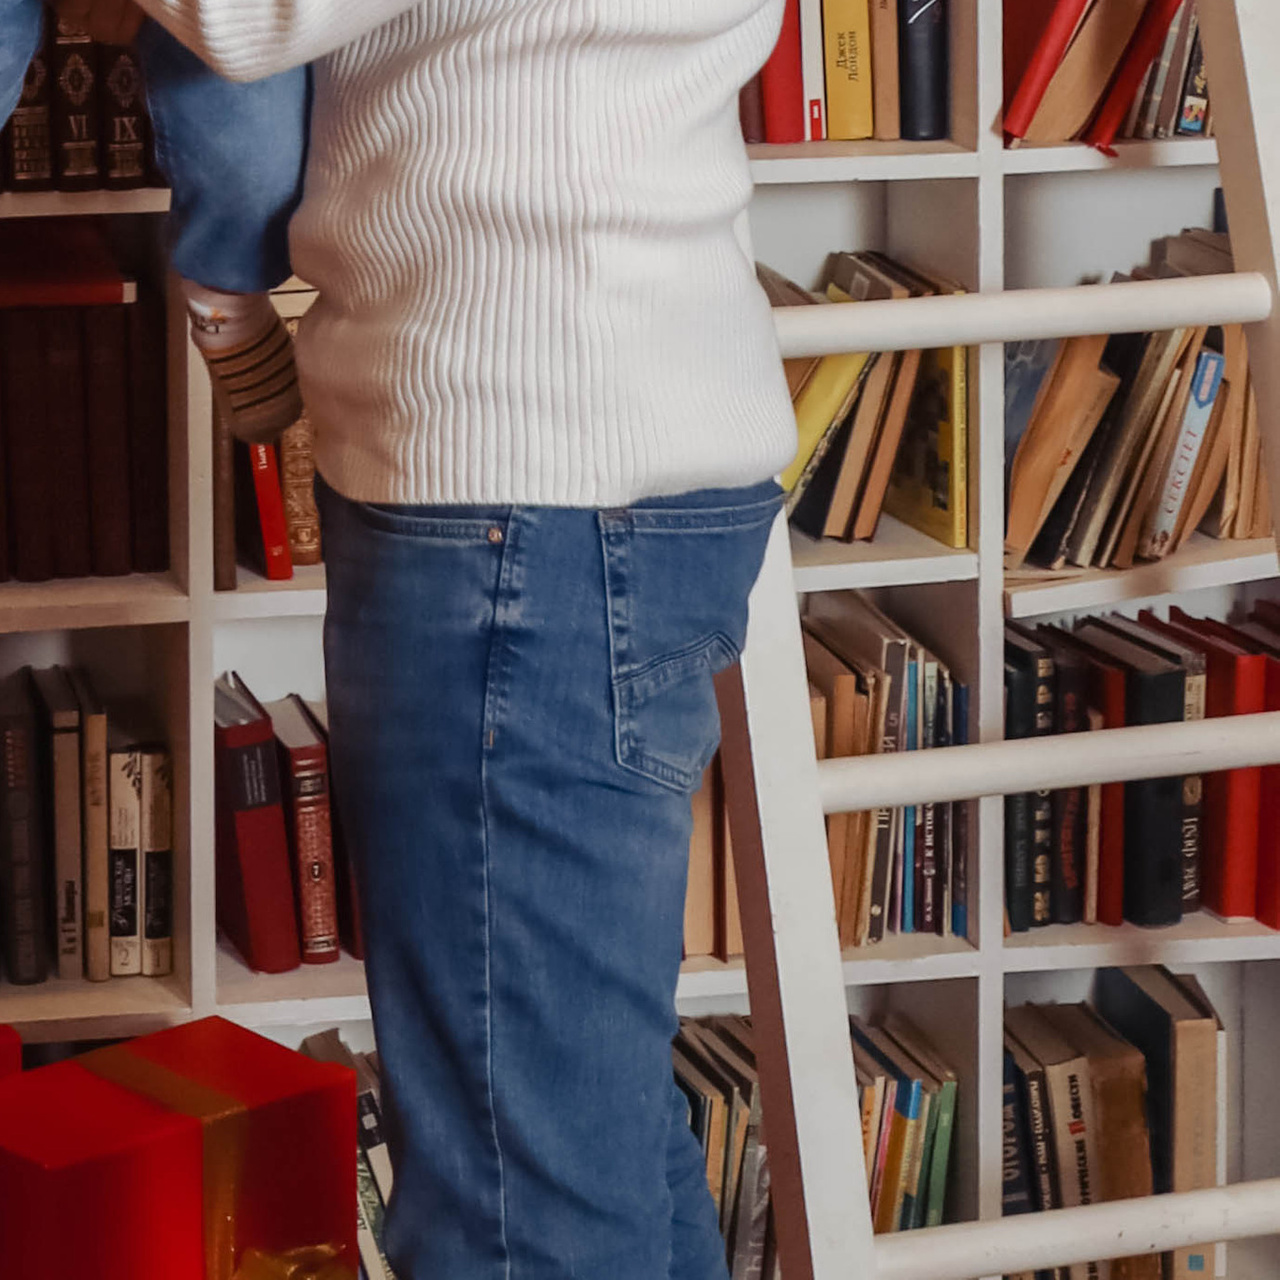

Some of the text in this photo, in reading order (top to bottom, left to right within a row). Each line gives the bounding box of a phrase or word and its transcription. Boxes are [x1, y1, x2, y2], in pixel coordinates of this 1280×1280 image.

[835, 31, 848, 71] Джек
[847, 30, 860, 83] Лондон
[69, 116, 90, 140] VI
[114, 117, 136, 141] IX
[120, 950, 130, 968] 2
[1068, 1073, 1085, 1134] ПОВЕСТИ
